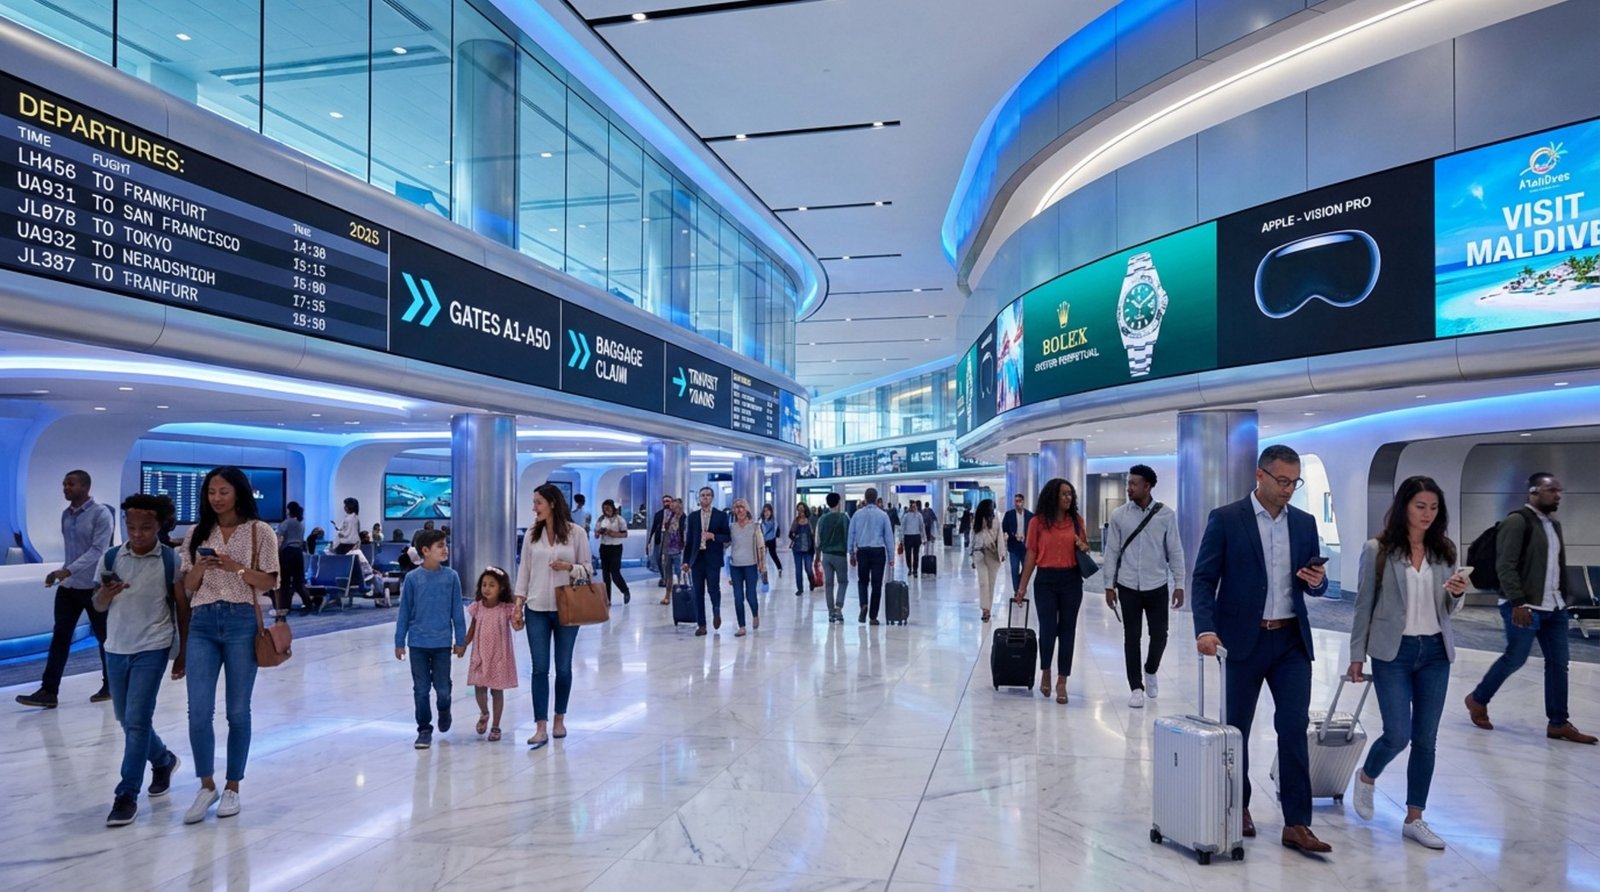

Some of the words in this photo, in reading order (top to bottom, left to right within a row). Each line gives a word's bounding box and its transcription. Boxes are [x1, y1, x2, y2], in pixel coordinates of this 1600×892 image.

[17, 126, 51, 147] TIME
[19, 92, 185, 173] DEPARTURES:
[19, 147, 76, 179] LH456
[92, 171, 114, 191] TO
[123, 181, 207, 221] FRANKFURT
[17, 171, 76, 204] UA931
[92, 194, 114, 214] TO
[123, 204, 153, 227] SAN
[162, 216, 240, 252] FRANCISCO
[1261, 215, 1295, 233] APPLE
[1303, 203, 1343, 221] VISION
[1345, 196, 1372, 212] PRO
[1502, 191, 1585, 231] VISIT
[17, 221, 76, 250] UA932
[91, 240, 114, 259] TO
[92, 217, 114, 237] TO
[123, 226, 172, 253] TOKYO
[17, 247, 76, 272] JL387
[91, 263, 114, 282] TO
[449, 300, 501, 336] GATES
[503, 318, 551, 350] A1-A50
